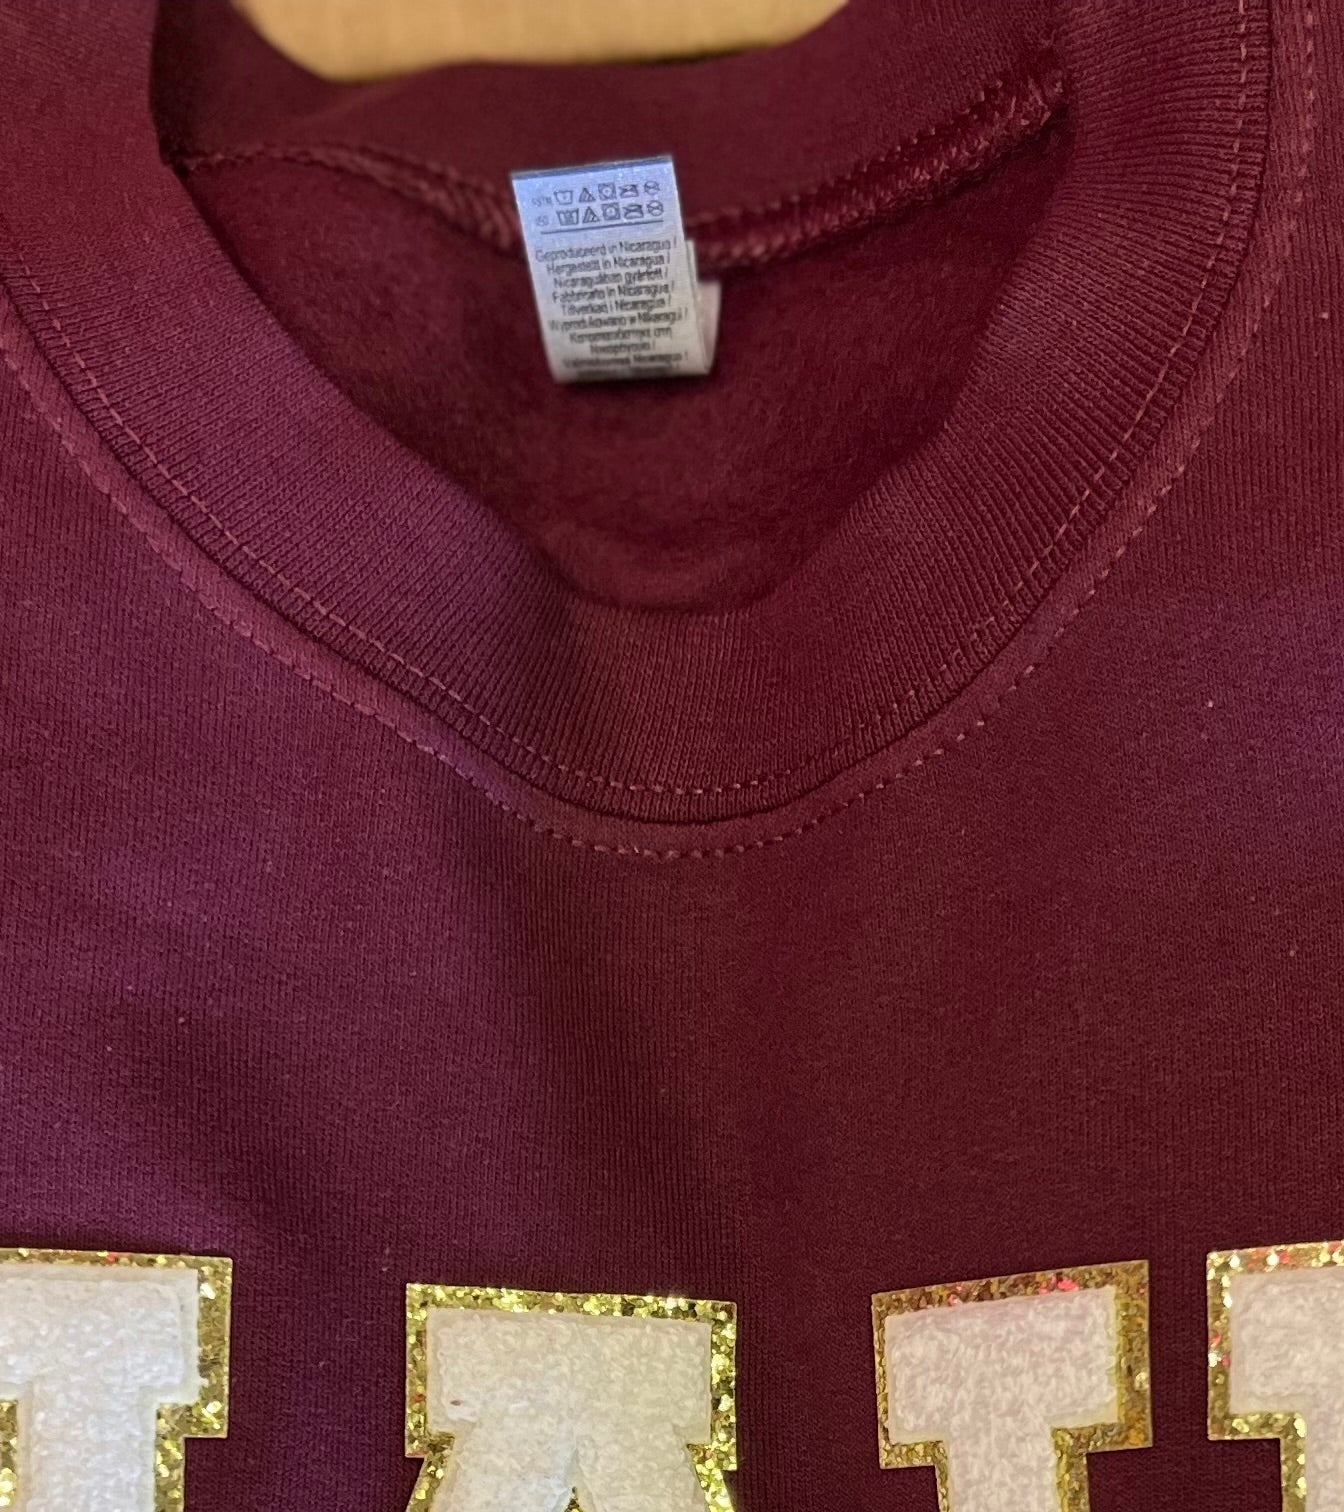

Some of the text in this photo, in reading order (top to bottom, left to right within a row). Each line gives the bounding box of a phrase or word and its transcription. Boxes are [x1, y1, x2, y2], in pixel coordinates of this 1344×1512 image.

[619, 240, 671, 254] Nicaragua
[613, 254, 665, 269] Nicaragua
[617, 283, 670, 299] Nicaragua
[614, 298, 666, 313] Nicaragua
